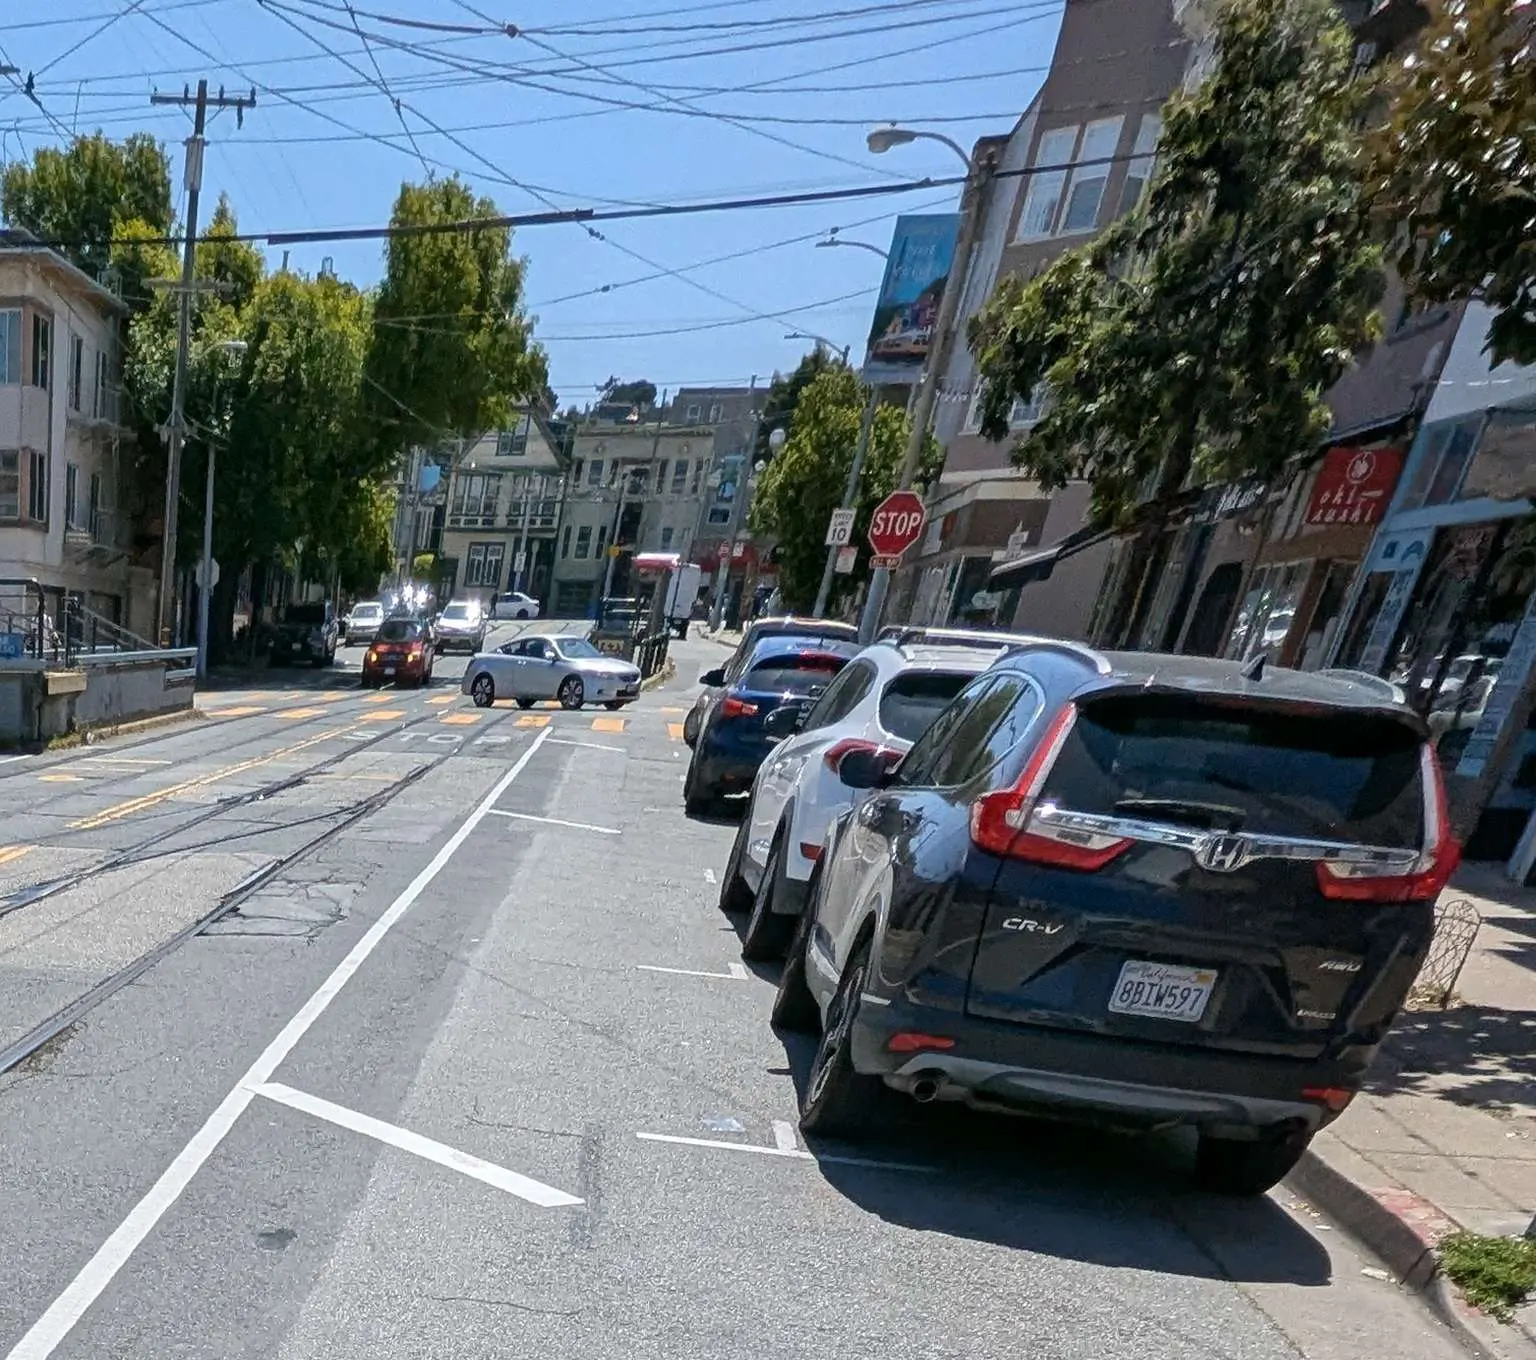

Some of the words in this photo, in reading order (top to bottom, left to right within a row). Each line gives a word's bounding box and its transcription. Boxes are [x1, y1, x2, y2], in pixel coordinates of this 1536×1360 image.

[872, 511, 922, 537] STOP
[831, 527, 847, 542] 10
[342, 730, 512, 746] STOP
[1002, 918, 1065, 935] CR-V
[1119, 980, 1204, 1013] 8BIW597
